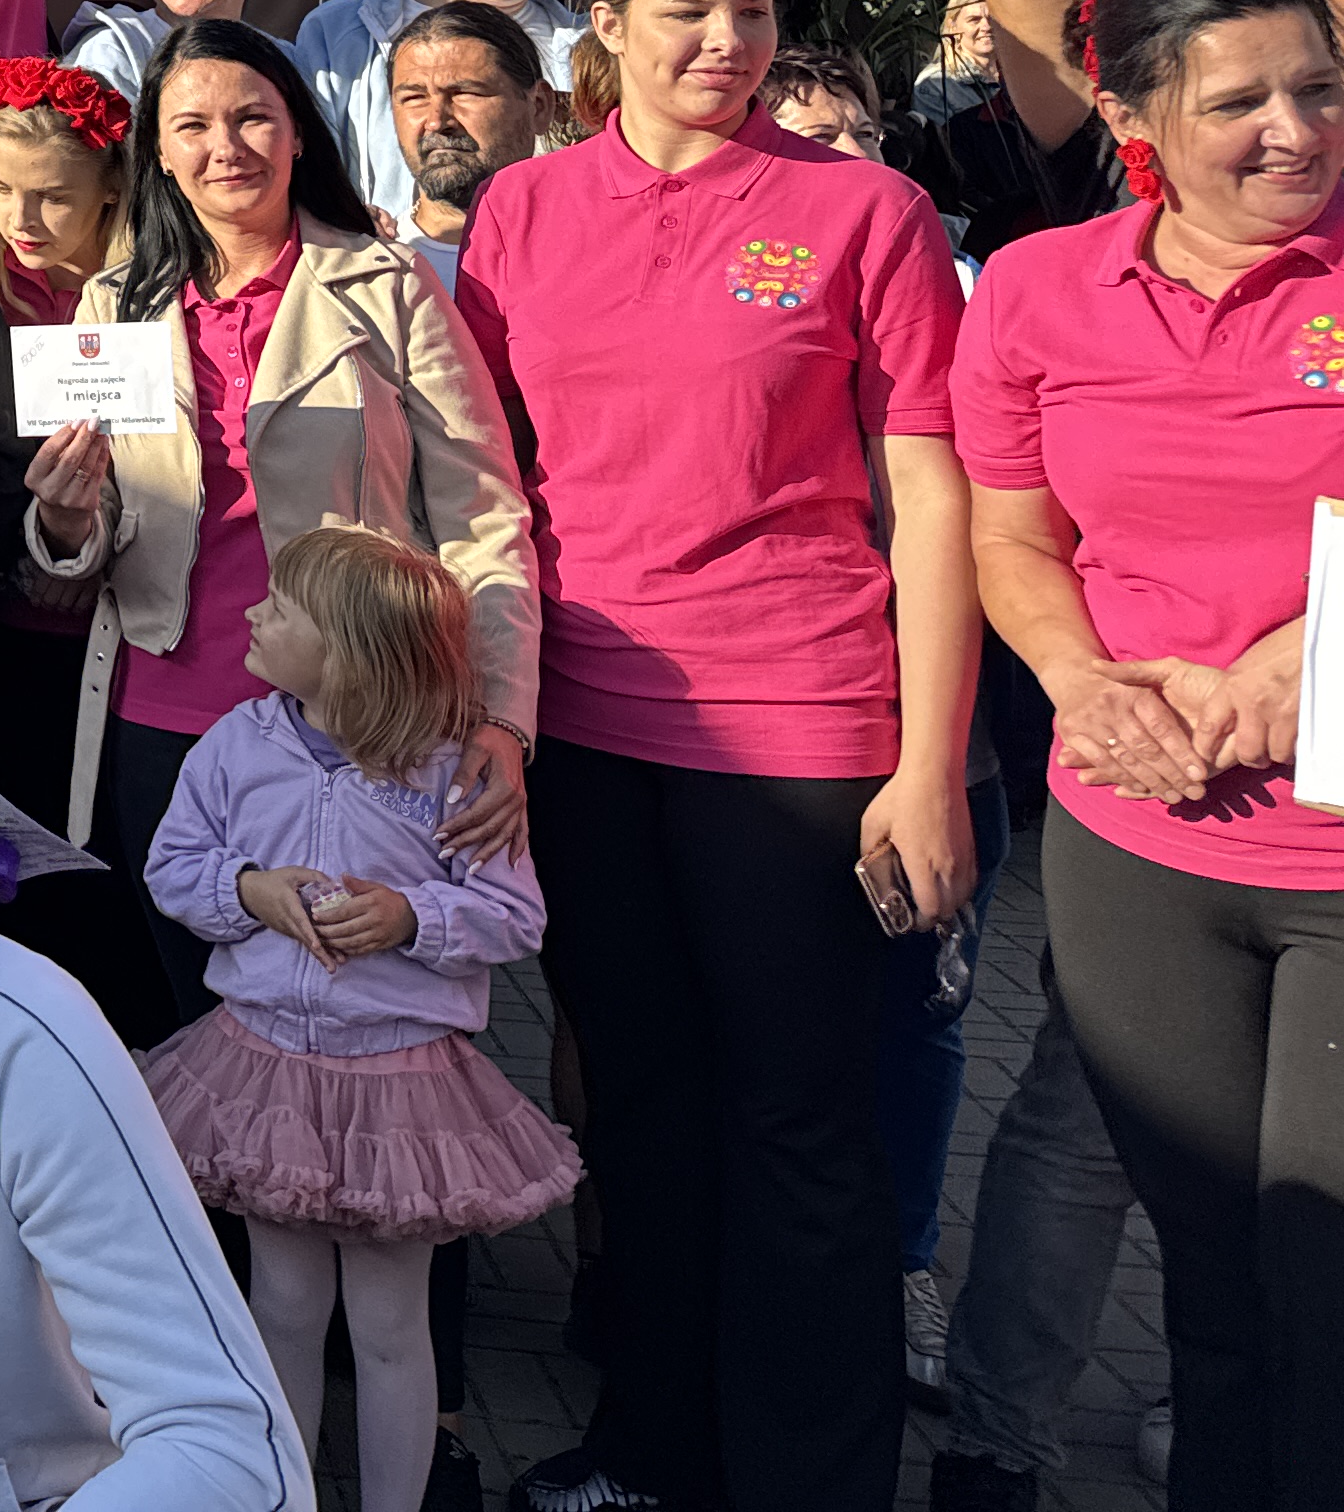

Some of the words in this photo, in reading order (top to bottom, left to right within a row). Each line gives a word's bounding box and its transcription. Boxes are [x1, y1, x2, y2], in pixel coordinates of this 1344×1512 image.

[57, 377, 88, 385] Nagroda
[73, 389, 122, 403] miejsca
[370, 789, 434, 829] SEASON
